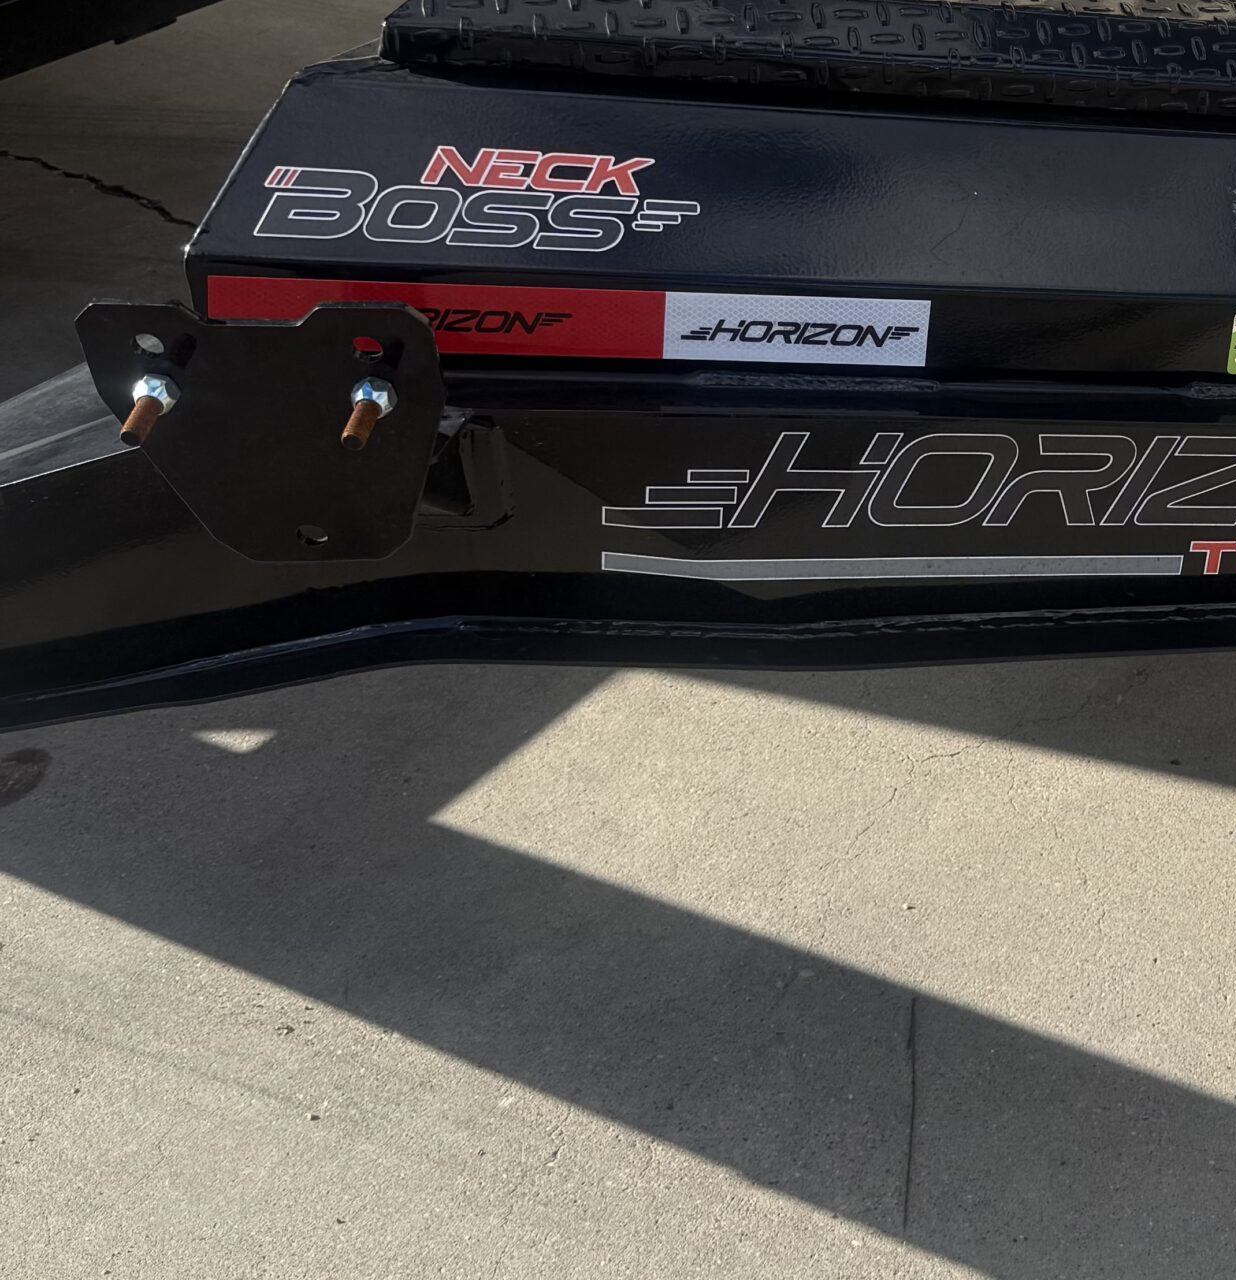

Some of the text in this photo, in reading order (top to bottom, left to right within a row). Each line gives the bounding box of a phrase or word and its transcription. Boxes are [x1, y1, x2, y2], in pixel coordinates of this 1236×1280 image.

[421, 145, 655, 196] NECK
[414, 307, 543, 336] RIZON
[708, 319, 894, 348] HORIZON
